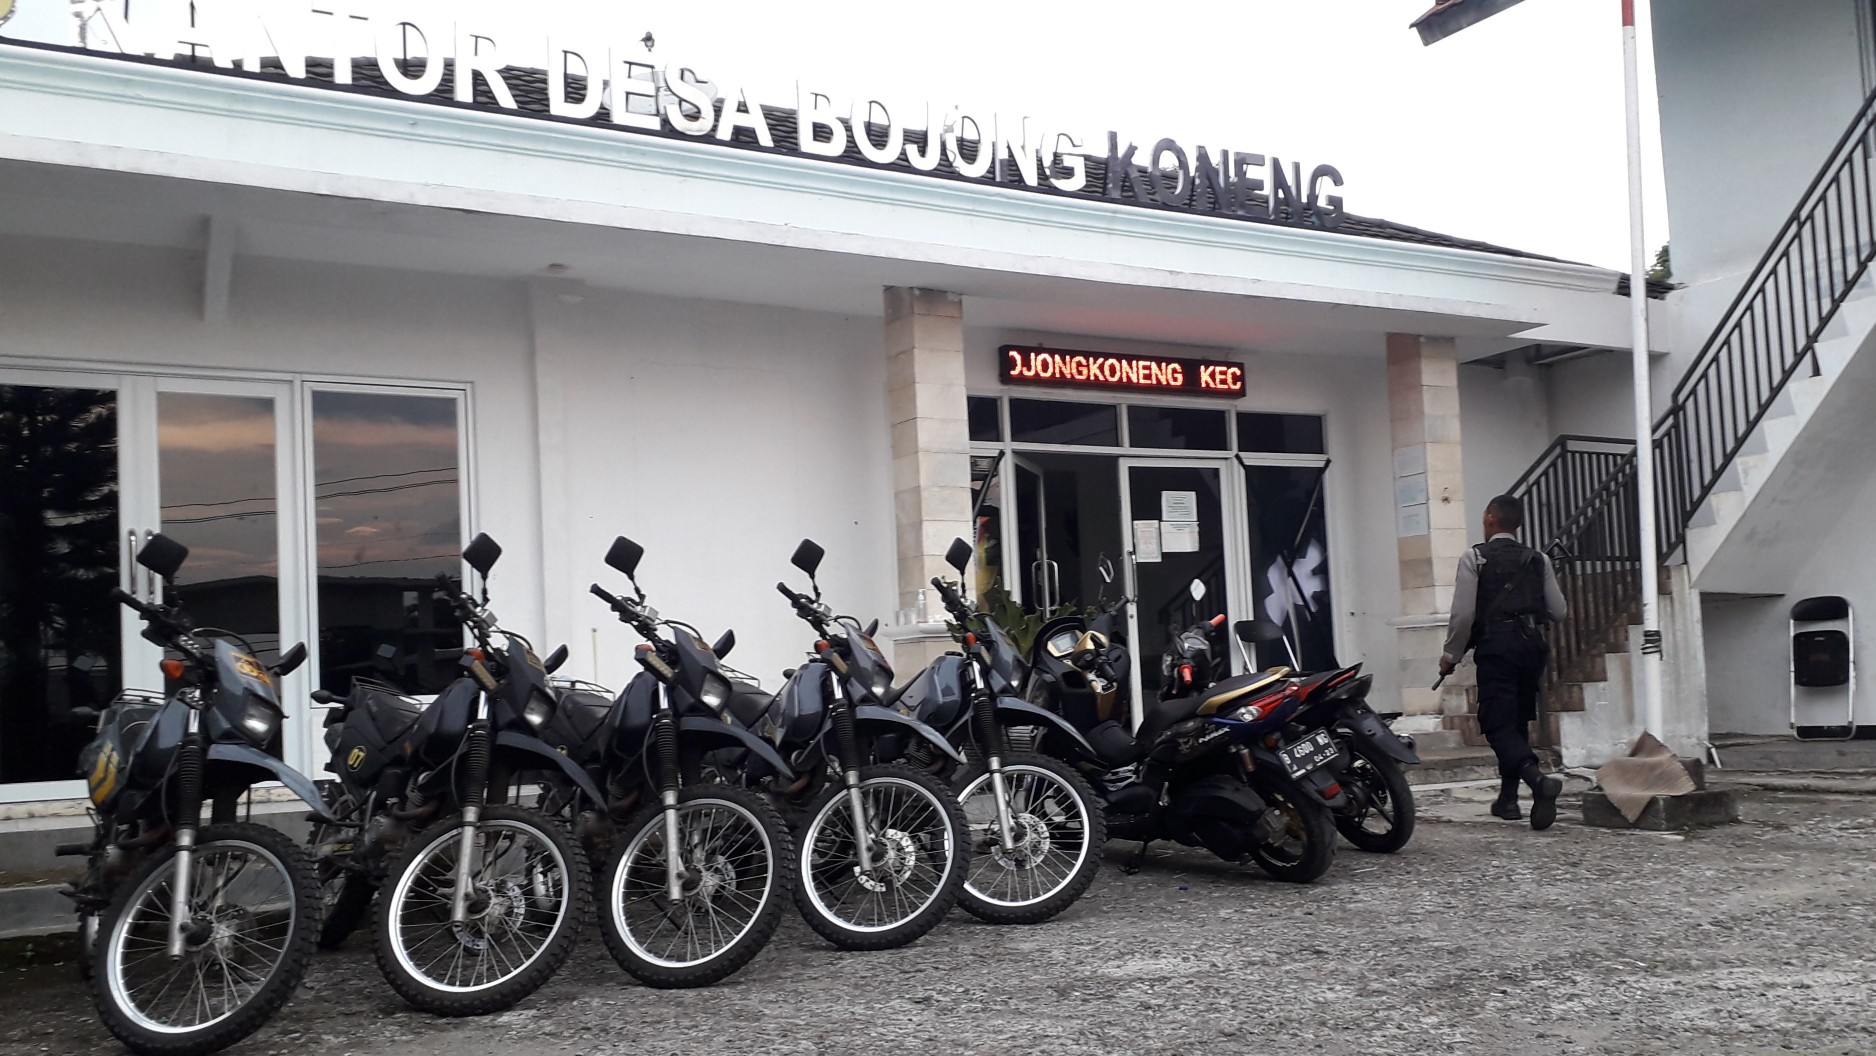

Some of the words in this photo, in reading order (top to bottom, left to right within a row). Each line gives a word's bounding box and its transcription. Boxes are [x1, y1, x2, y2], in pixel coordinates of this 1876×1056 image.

[547, 34, 774, 148] DESA
[797, 80, 1085, 192] BOJONG
[1104, 131, 1345, 228] KONENG
[1200, 365, 1242, 390] KEC
